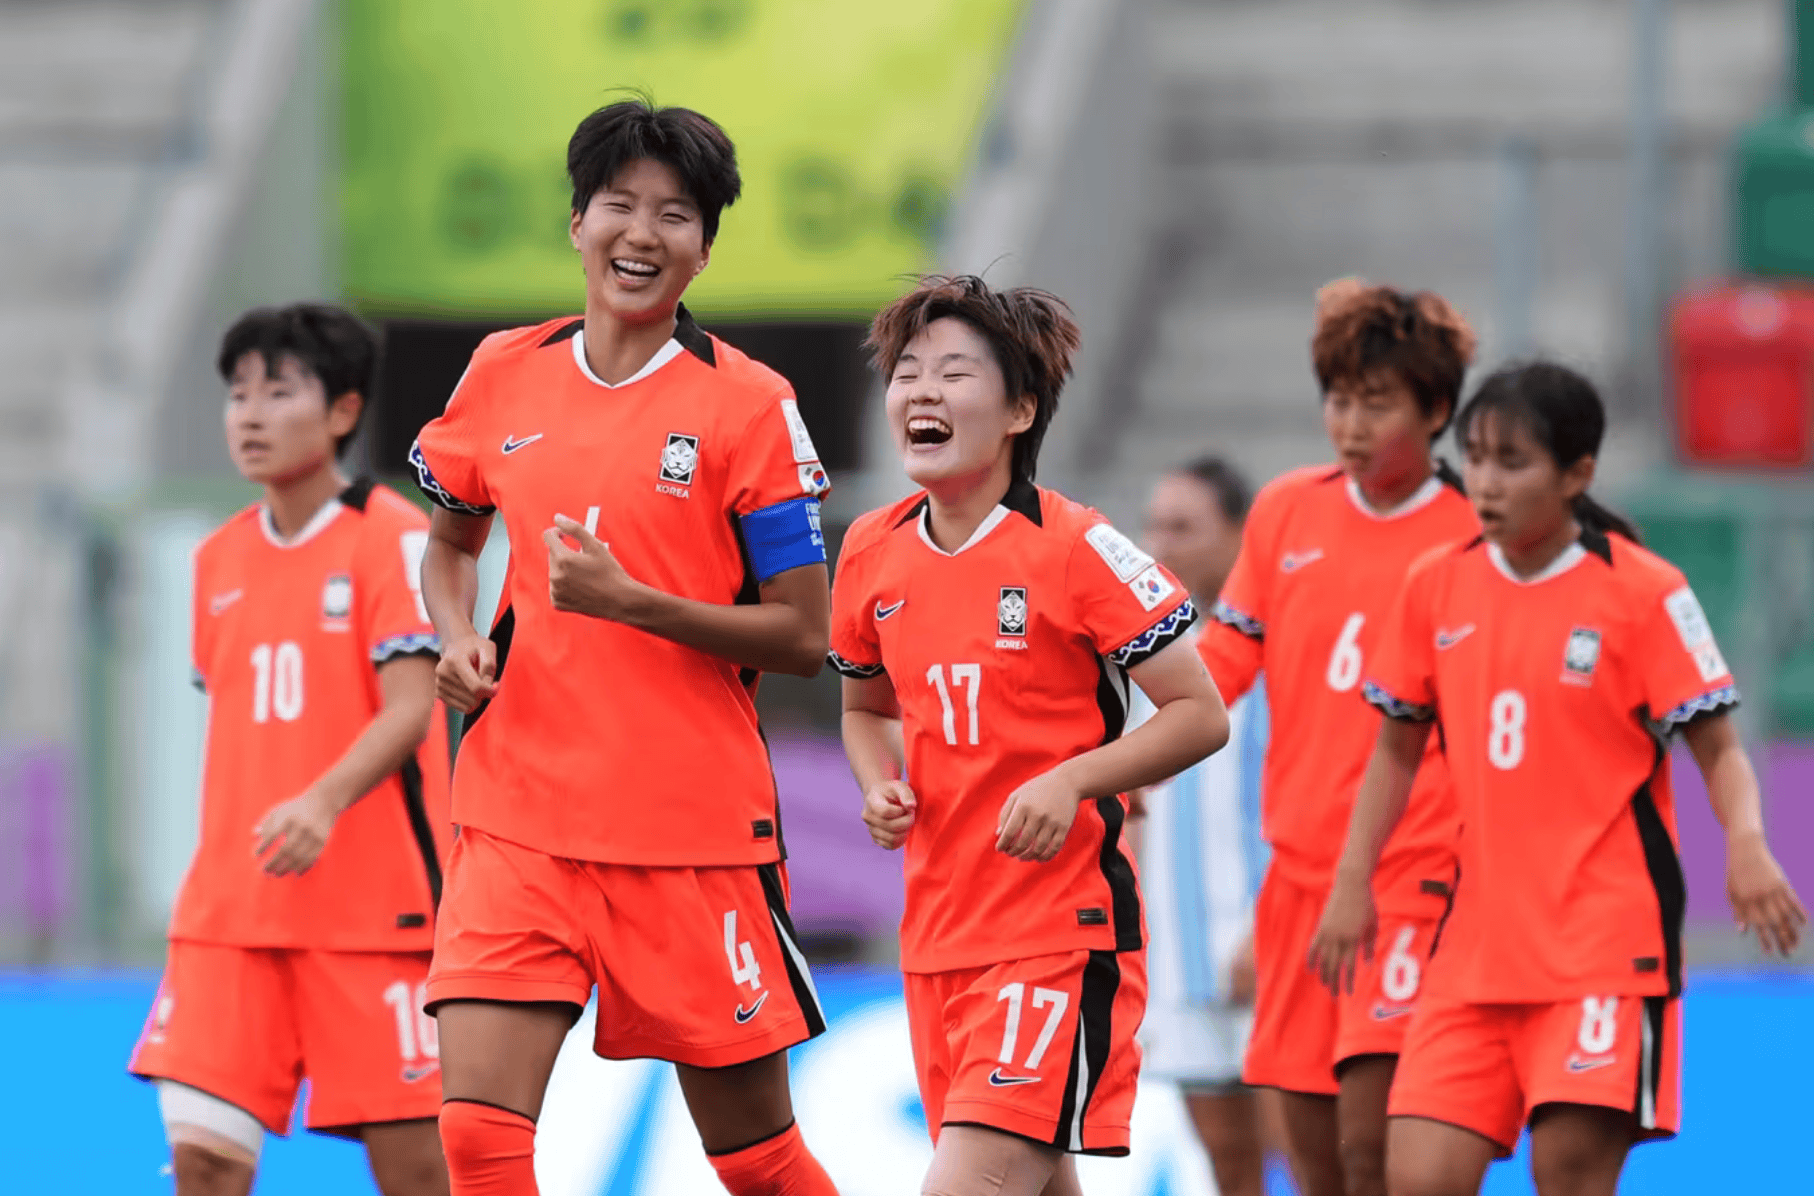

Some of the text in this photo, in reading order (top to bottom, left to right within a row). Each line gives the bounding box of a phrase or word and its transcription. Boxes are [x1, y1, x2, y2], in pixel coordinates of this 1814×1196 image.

[656, 484, 690, 499] KOREA
[250, 640, 304, 723] 10
[1326, 612, 1366, 692] 6
[926, 663, 981, 745] 17
[1489, 688, 1527, 770] 8
[724, 910, 762, 991] 4
[1382, 924, 1420, 1001] 6
[998, 982, 1069, 1069] 17
[1579, 995, 1617, 1053] 8
